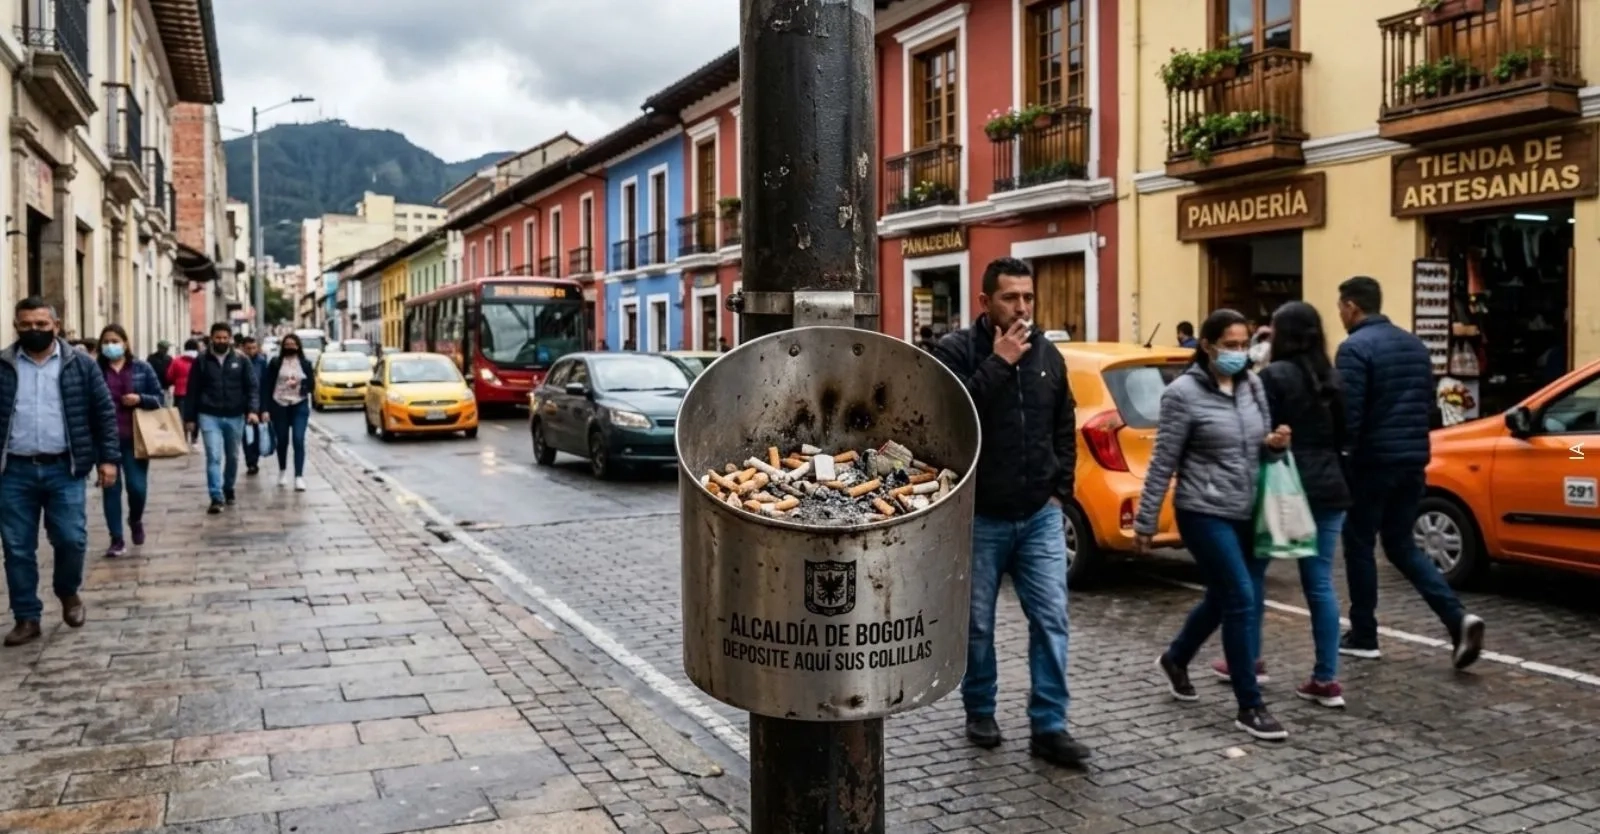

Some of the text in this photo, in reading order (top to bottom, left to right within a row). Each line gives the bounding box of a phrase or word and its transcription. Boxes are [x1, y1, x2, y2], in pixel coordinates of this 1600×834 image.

[1416, 135, 1564, 178] TIENDA DE
[1402, 164, 1581, 209] ARTESANÍAS
[1187, 186, 1308, 228] PANADERÍA
[1567, 484, 1594, 498] 291
[730, 609, 925, 647] ALCALDÍA DE BOGOTÁ
[723, 637, 933, 672] DEPOSITE AQUÍ SUS COLILLAS
